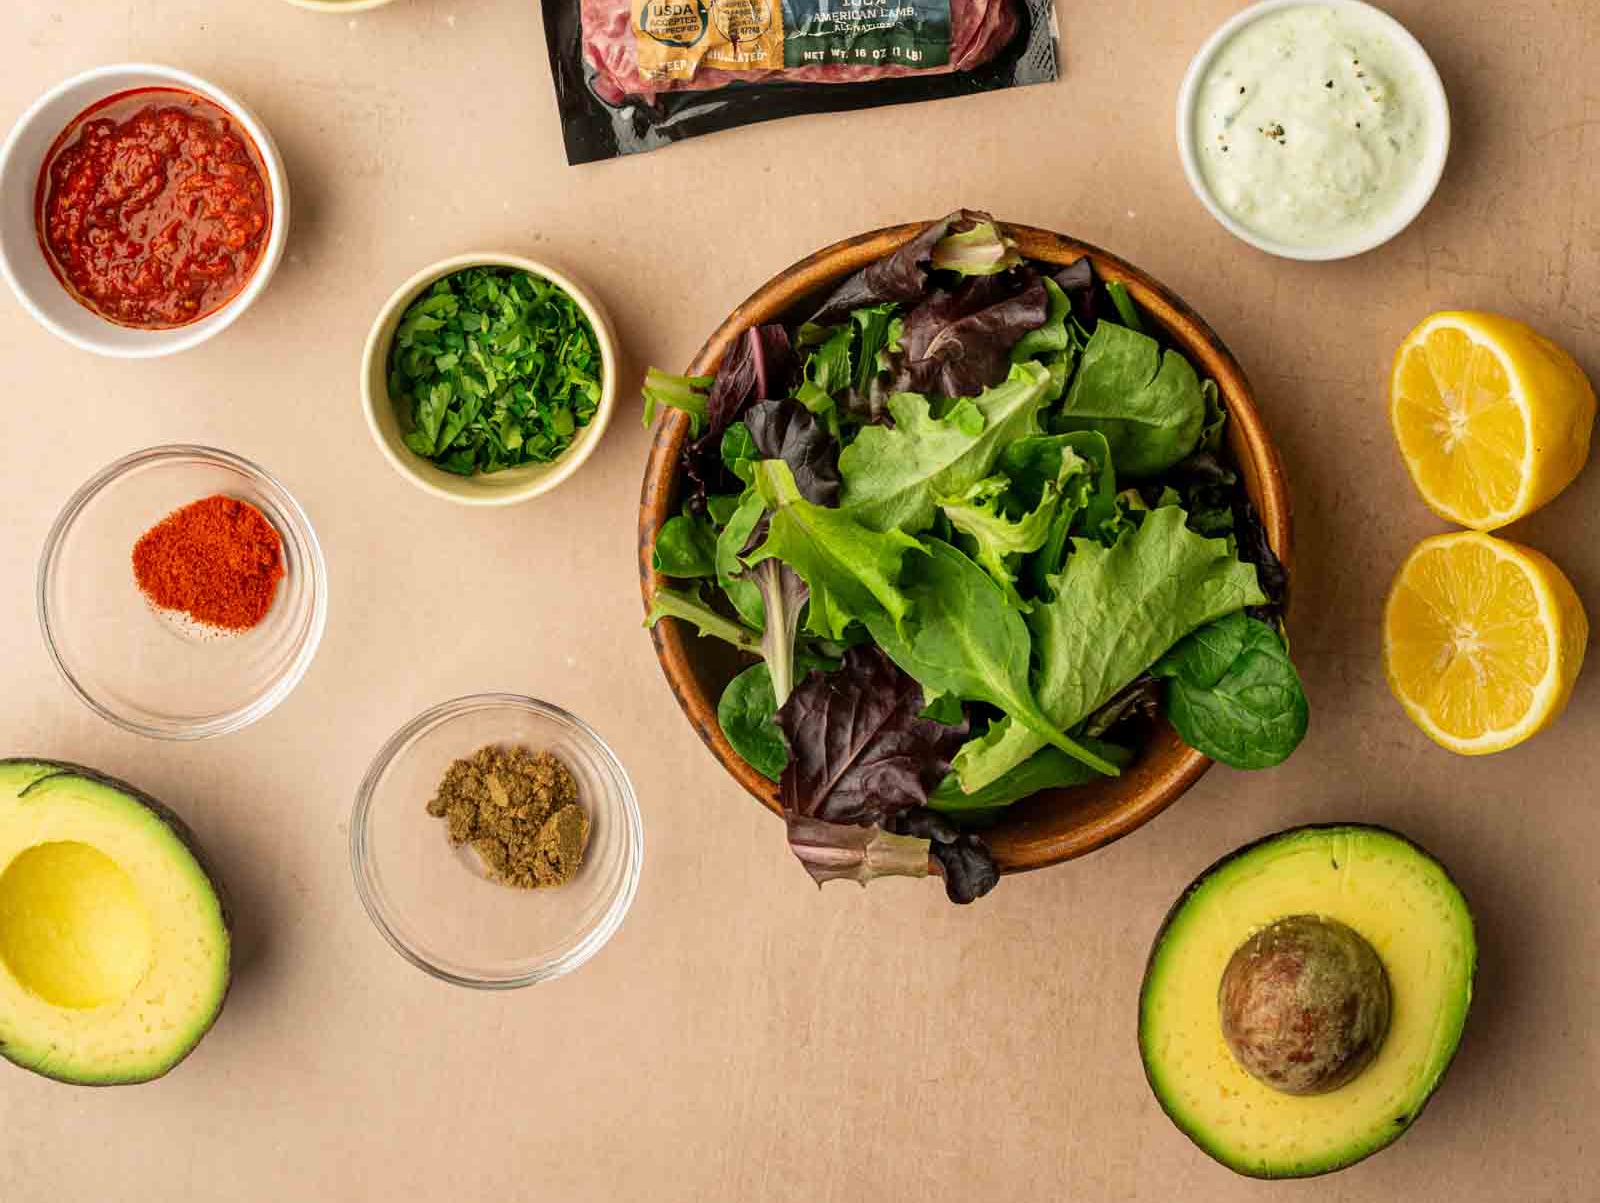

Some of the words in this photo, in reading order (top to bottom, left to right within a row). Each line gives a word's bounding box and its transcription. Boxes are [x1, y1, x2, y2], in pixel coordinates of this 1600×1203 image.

[653, 4, 693, 16] USDA
[814, 8, 877, 22] AMERICAN
[804, 51, 824, 60] NET
[831, 49, 848, 59] WT.
[855, 49, 866, 57] 16
[872, 49, 886, 59] OZ
